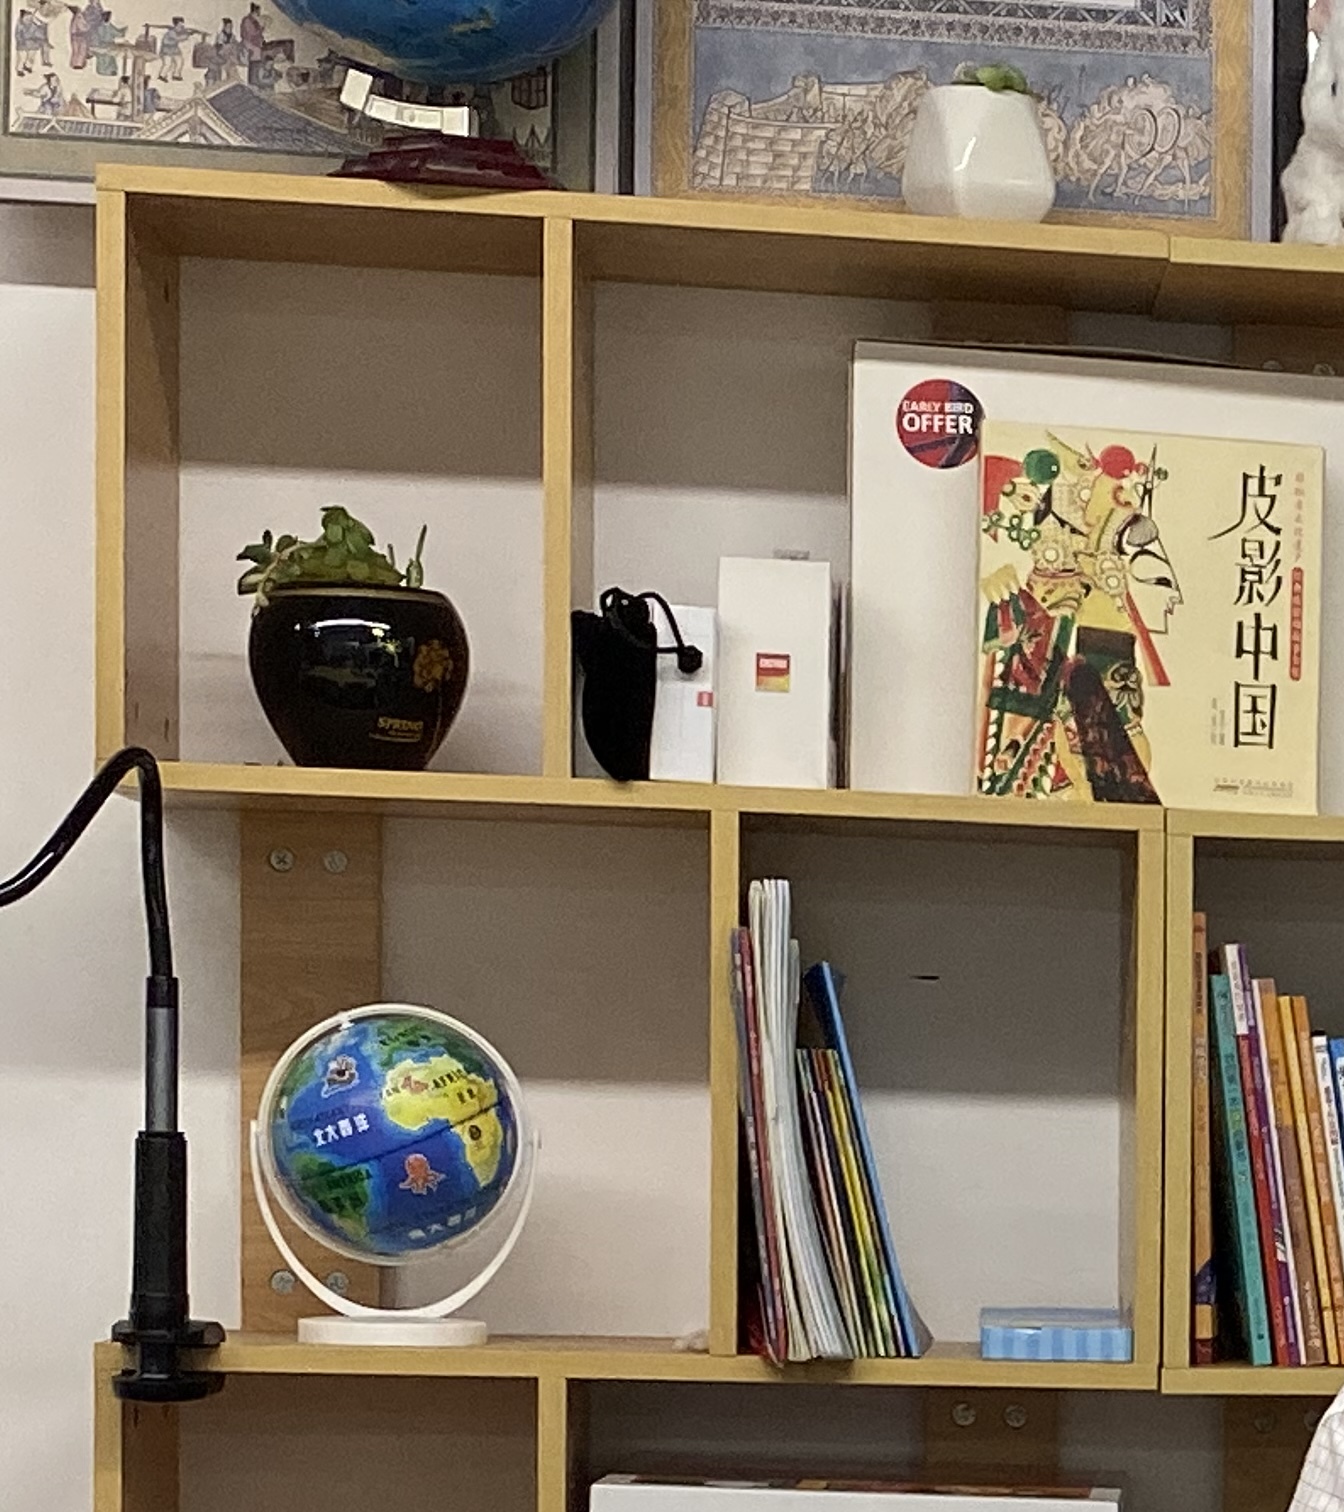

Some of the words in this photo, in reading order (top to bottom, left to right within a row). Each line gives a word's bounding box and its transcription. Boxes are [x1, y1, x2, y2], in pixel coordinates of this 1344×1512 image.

[902, 412, 974, 435] OFFER
[1207, 464, 1283, 749] 皮影中国
